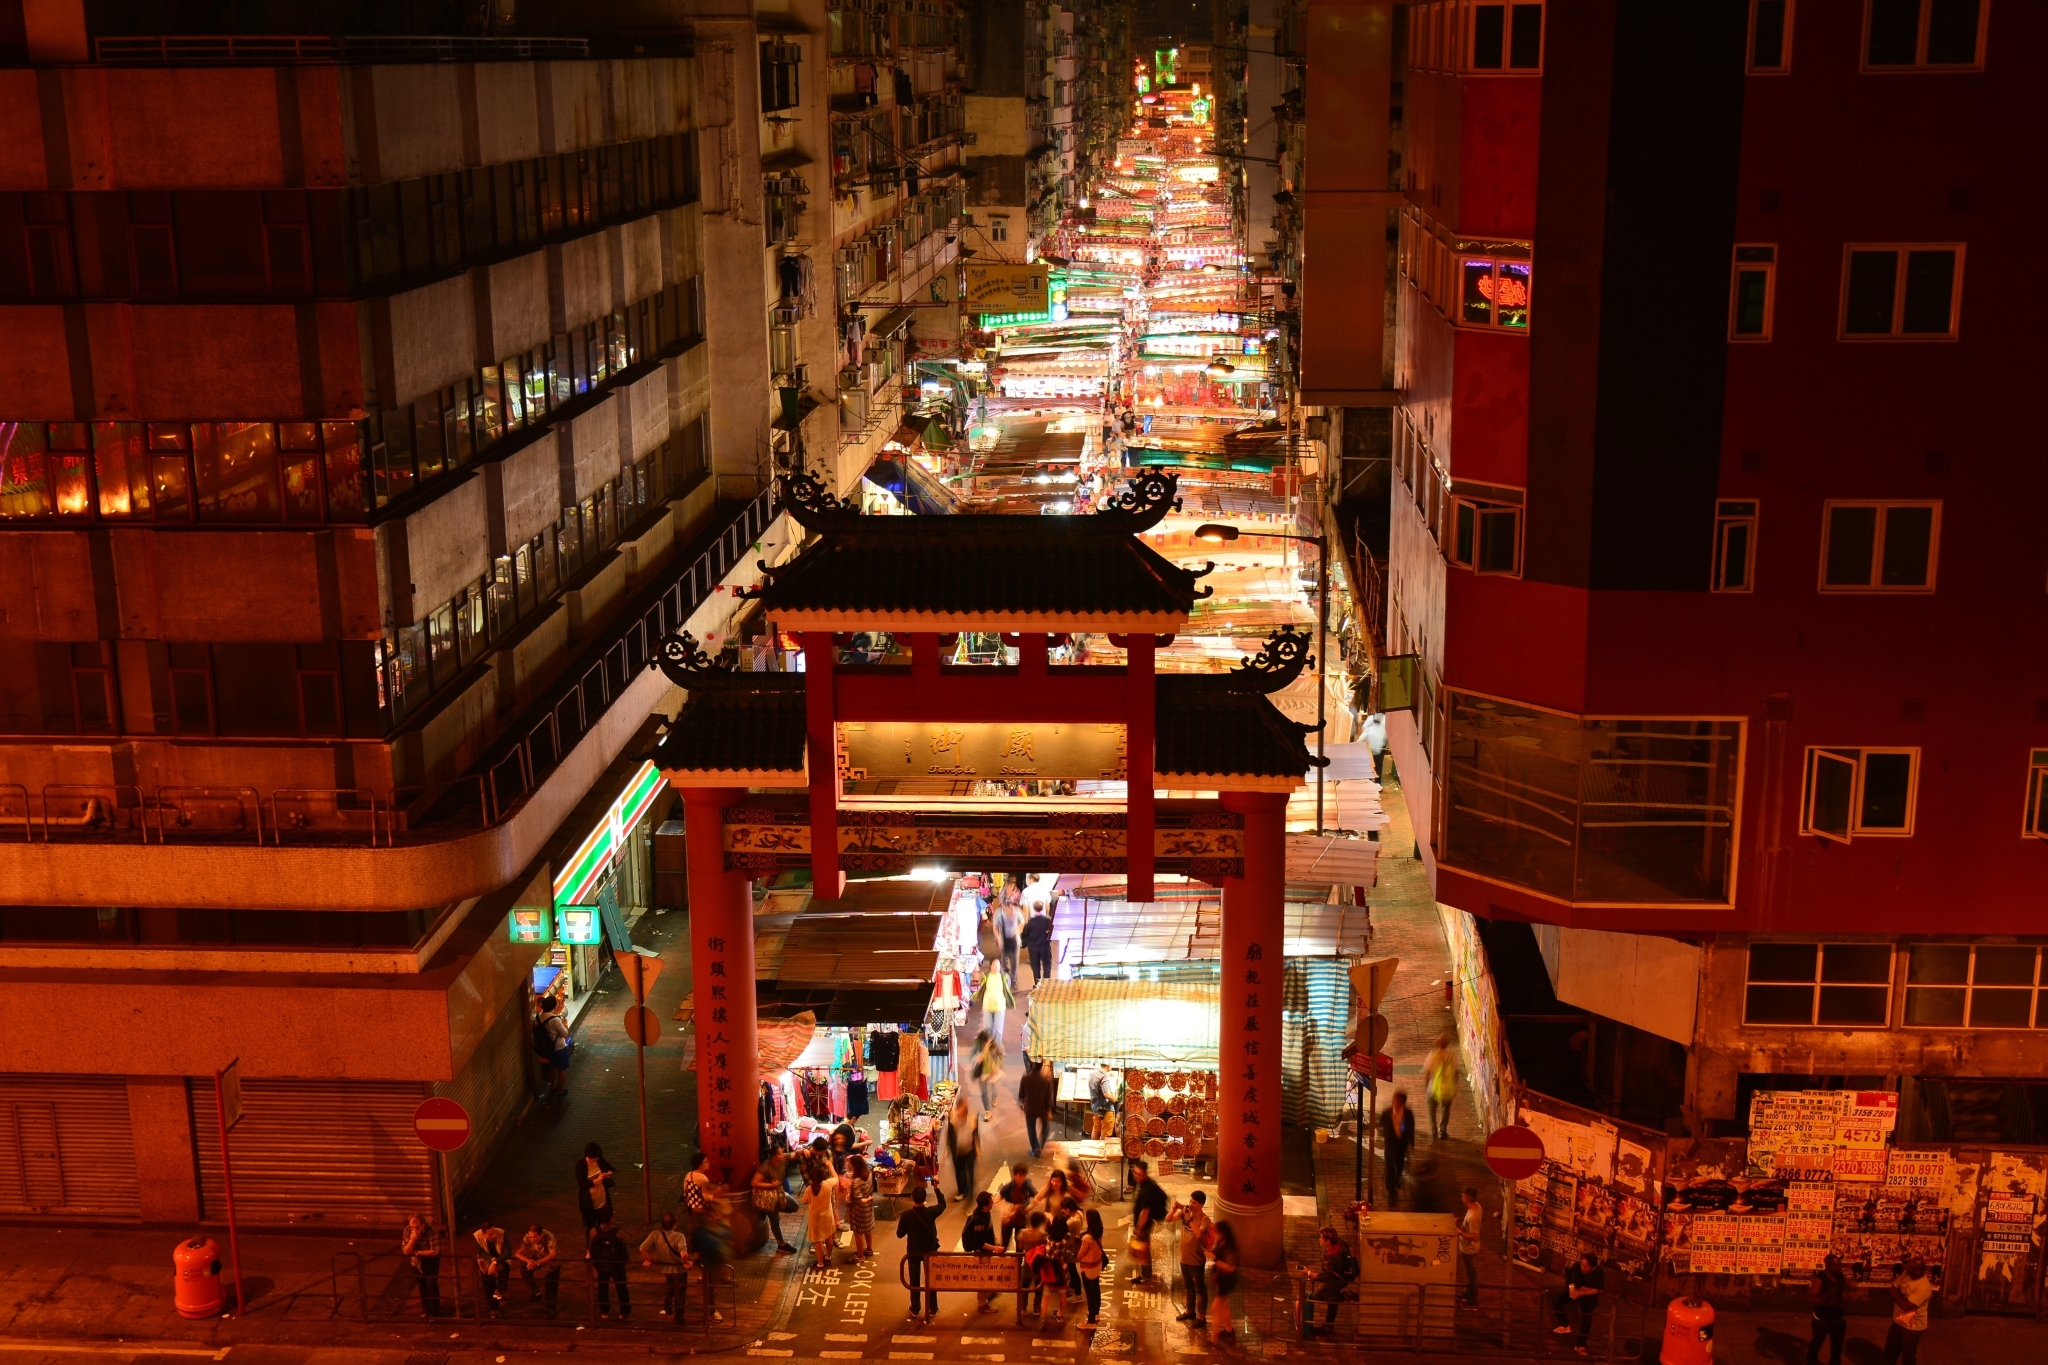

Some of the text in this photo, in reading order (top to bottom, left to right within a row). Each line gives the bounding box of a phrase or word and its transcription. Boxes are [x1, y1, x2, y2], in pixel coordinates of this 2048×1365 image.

[928, 765, 1037, 776] Temple Street
[1834, 1161, 1885, 1174] 2370-9889
[1889, 1164, 1944, 1175] 8100 8978
[1774, 1168, 1831, 1181] 2366 0772
[1888, 1176, 1907, 1185] 2827
[1908, 1176, 1928, 1186] 9818
[1787, 1226, 1829, 1234] 2698-2128
[840, 1252, 880, 1324] OOK LEFT
